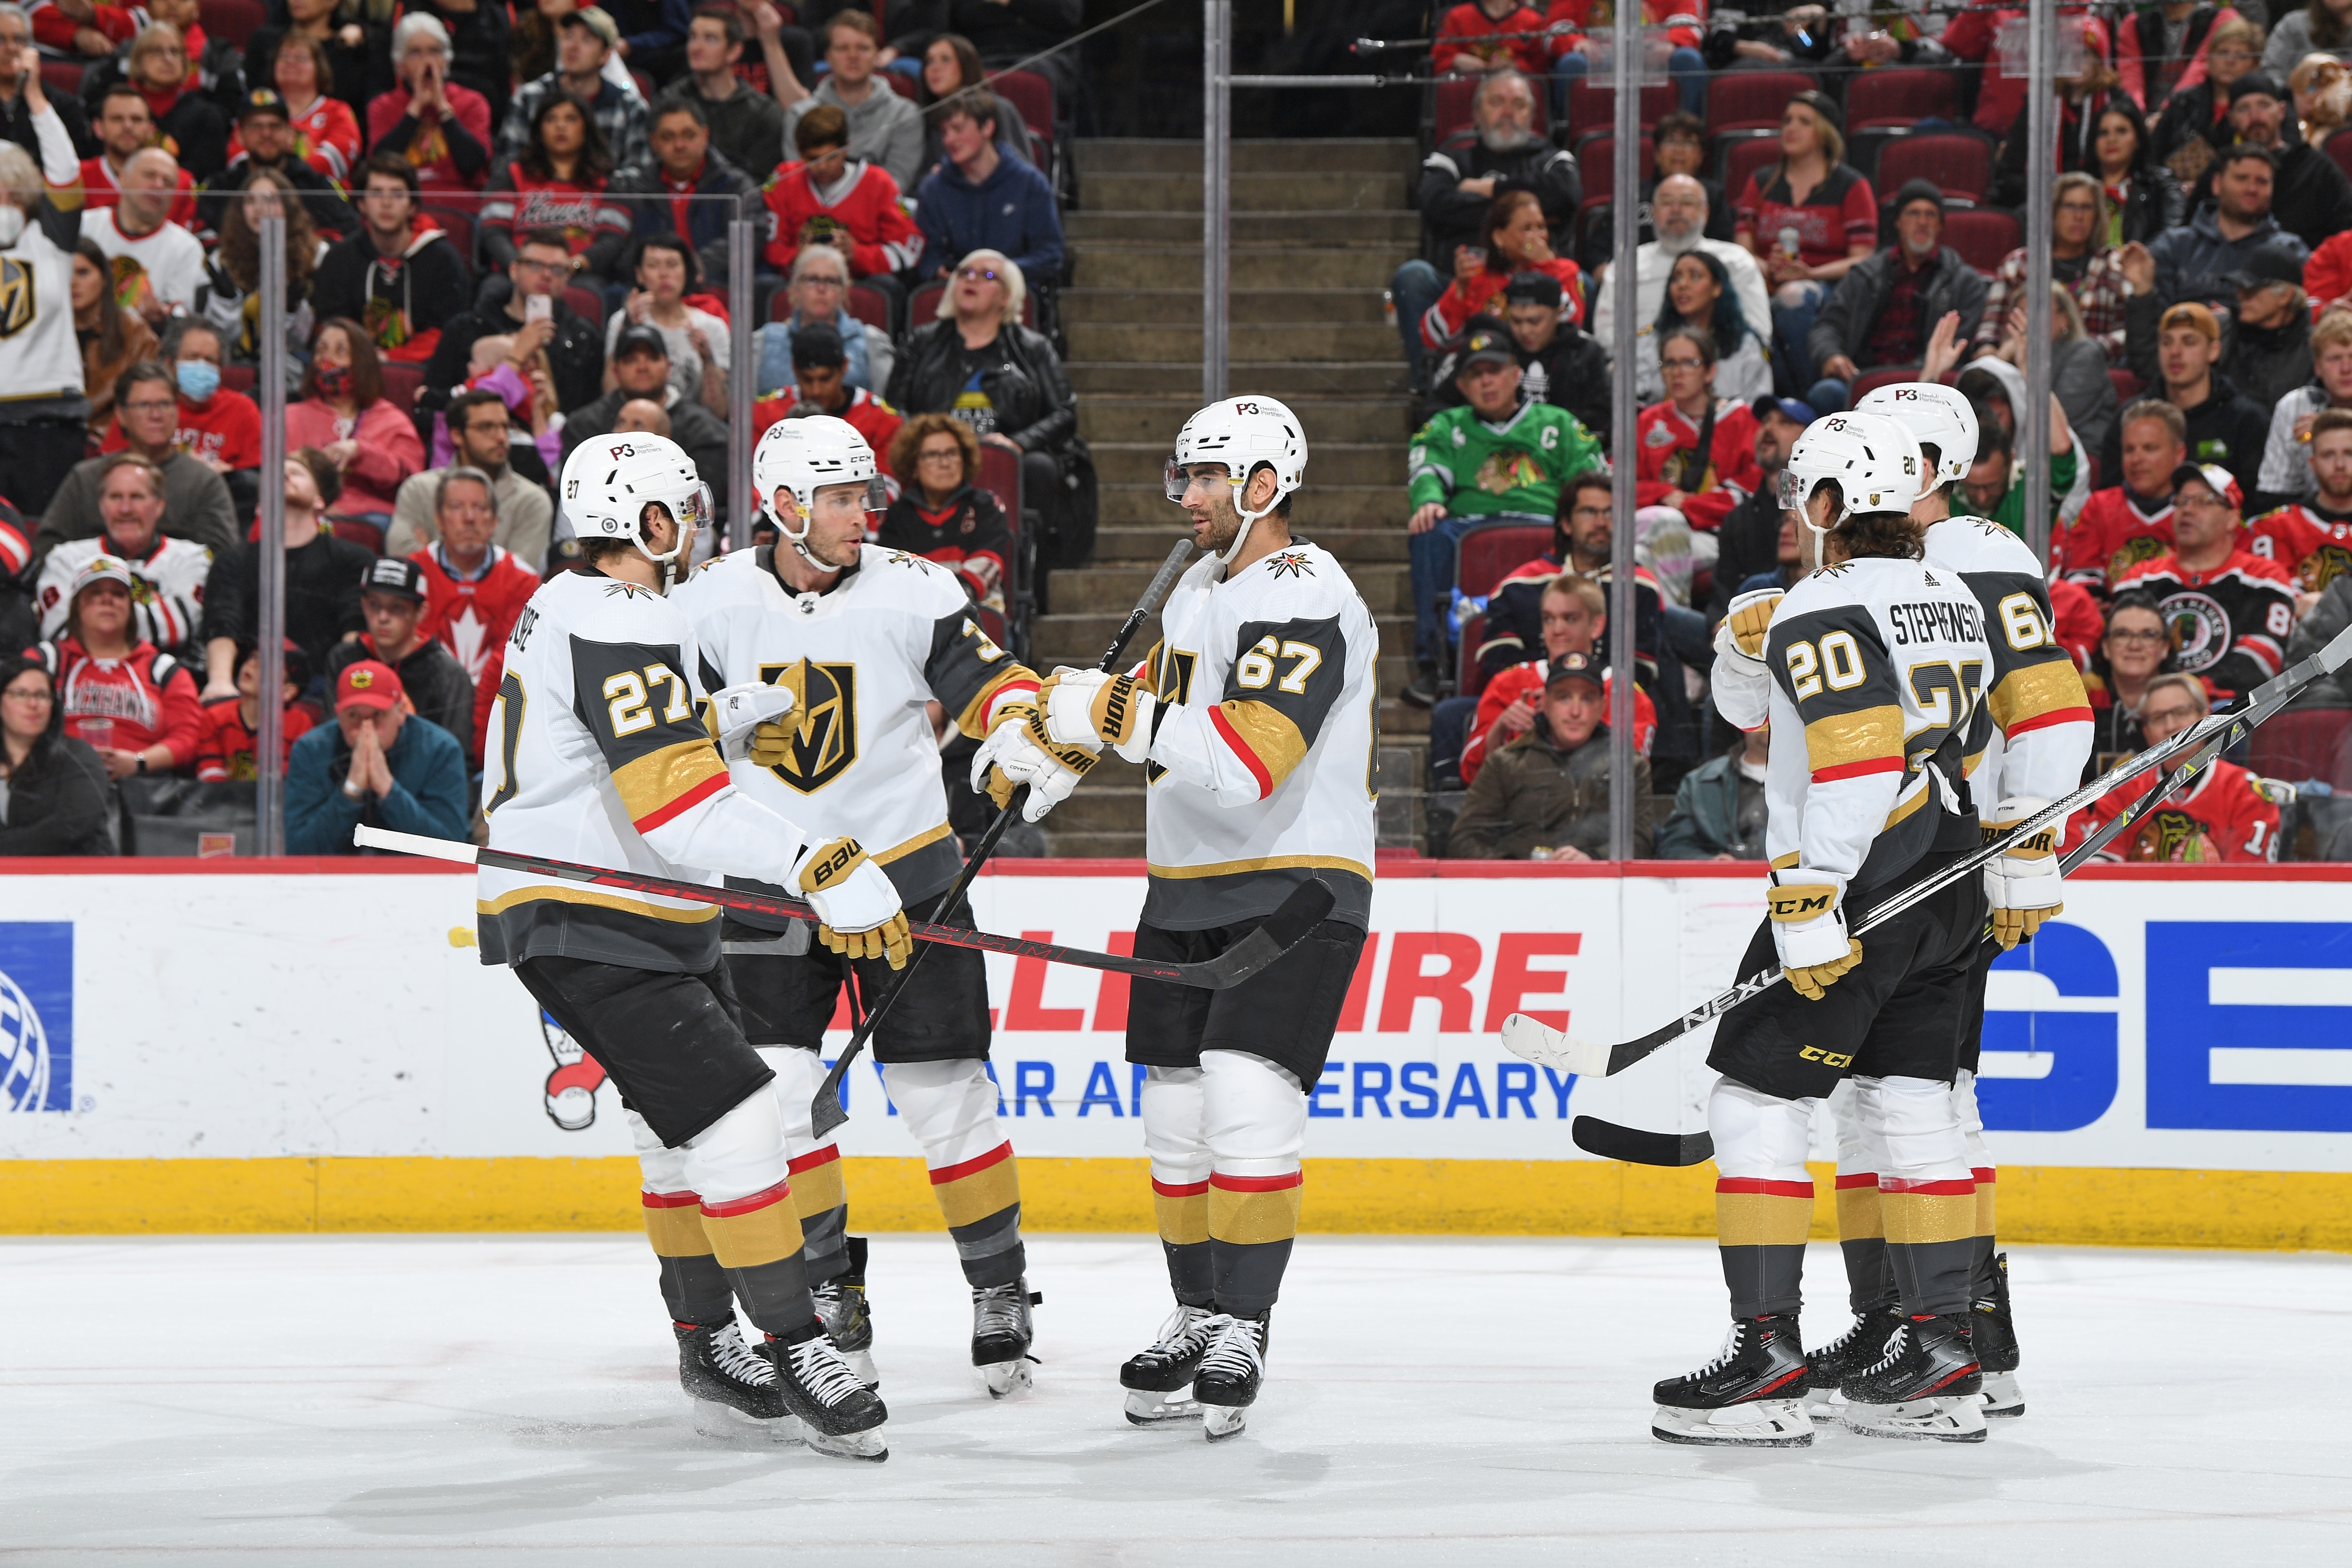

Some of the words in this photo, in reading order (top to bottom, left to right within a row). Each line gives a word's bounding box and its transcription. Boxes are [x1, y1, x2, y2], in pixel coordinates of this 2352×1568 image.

[1896, 389, 1917, 400] P3
[1236, 403, 1259, 415] P3
[1824, 418, 1847, 432] P3
[1845, 424, 1864, 433] Health
[767, 426, 784, 440] P3
[1540, 425, 1560, 450] C
[1843, 429, 1867, 440] Partners
[1177, 437, 1191, 446] CCM
[610, 444, 635, 461] P3
[636, 447, 662, 455] Partners
[1903, 455, 1916, 476] 20
[567, 480, 580, 500] 27
[1998, 591, 2056, 652] 6
[1237, 635, 1322, 695] 67
[1786, 630, 1867, 704] 20
[602, 663, 691, 739] 27
[1009, 764, 1031, 773] COVERT
[1335, 932, 1581, 1033] IRE
